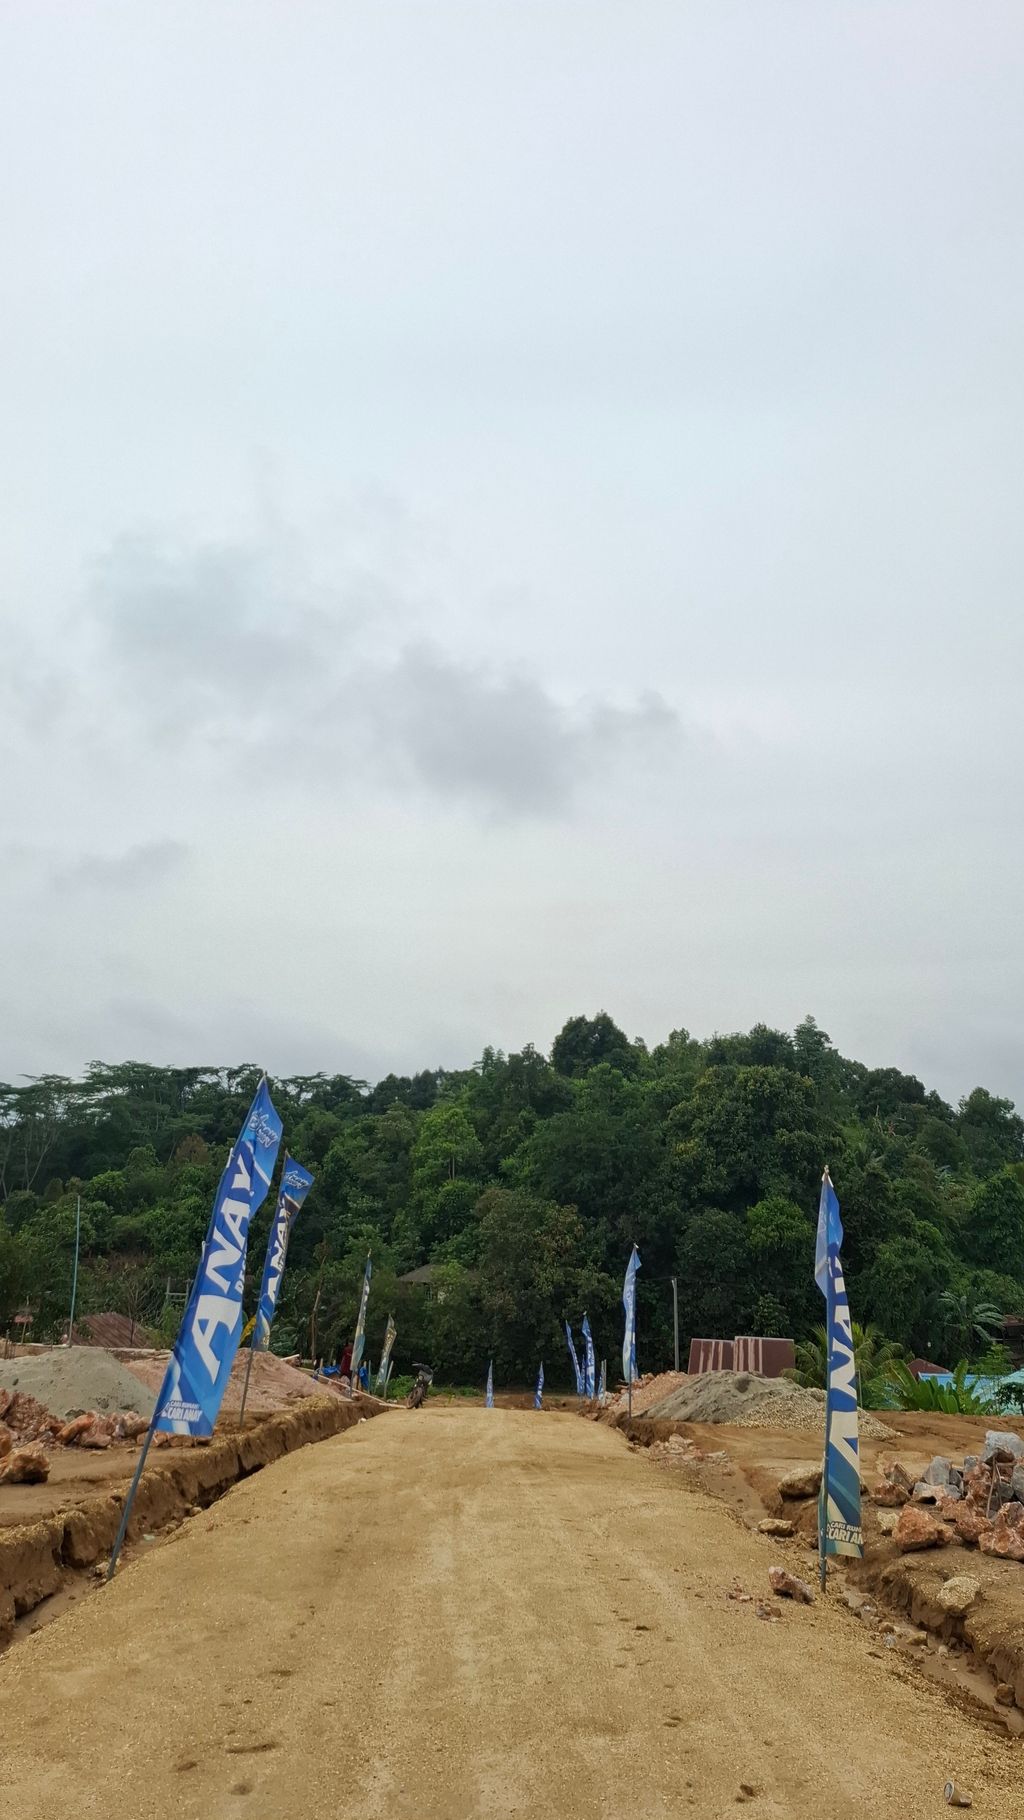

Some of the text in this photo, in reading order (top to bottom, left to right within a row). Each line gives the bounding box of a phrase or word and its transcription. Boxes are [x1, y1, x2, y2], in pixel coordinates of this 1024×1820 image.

[191, 1154, 251, 1385] ANAY
[167, 1407, 184, 1419] CARI
[829, 1529, 850, 1541] CARI
